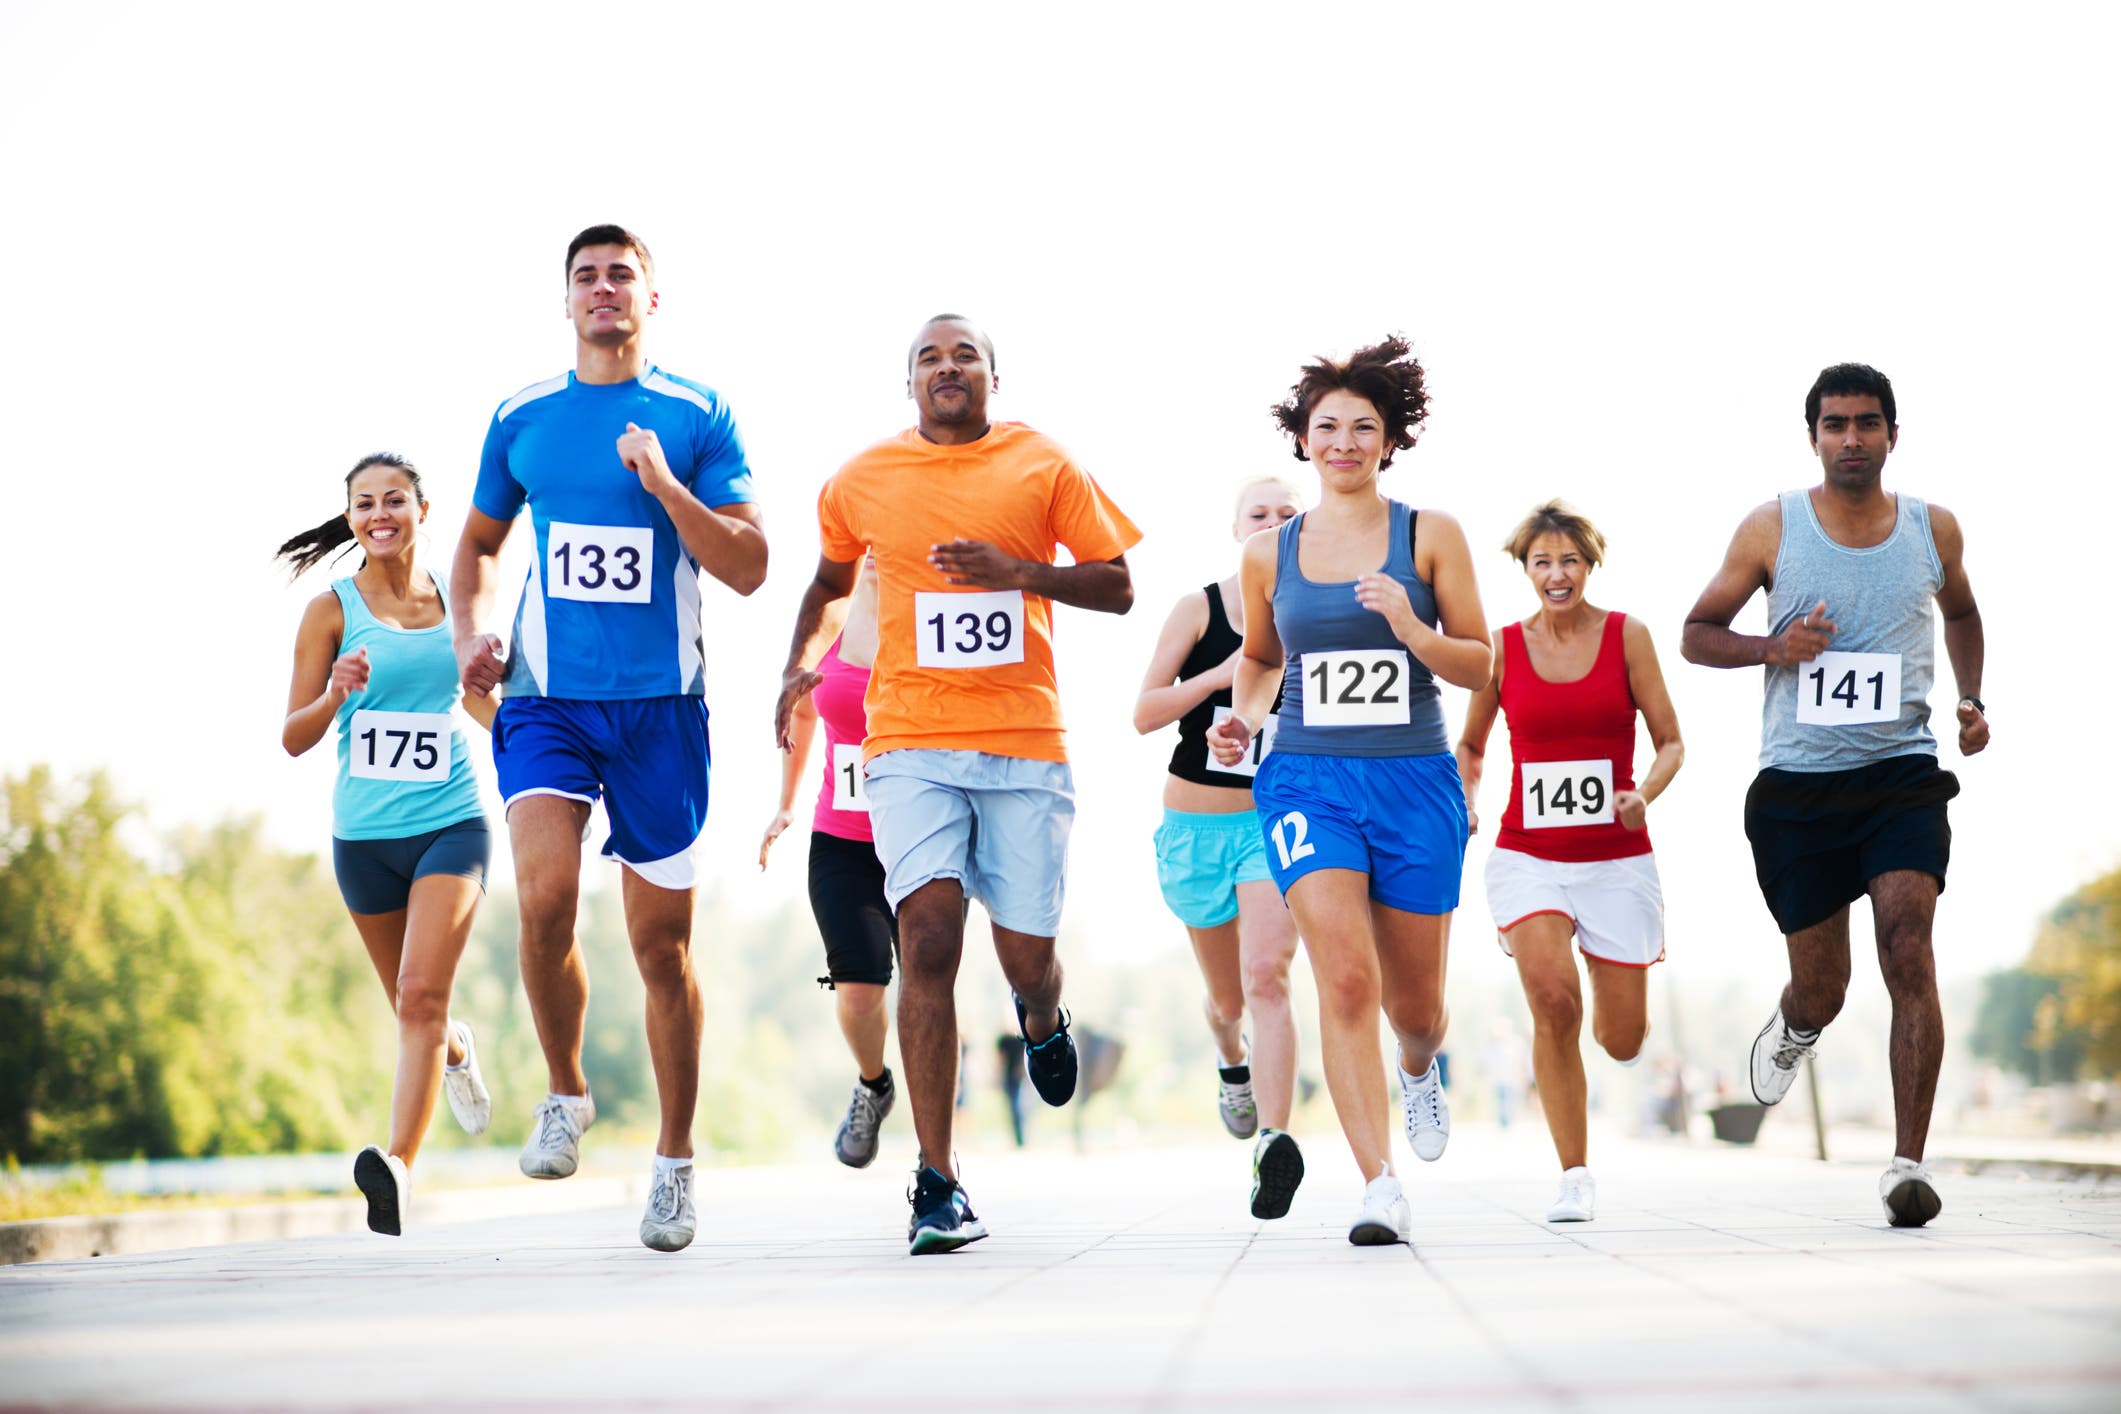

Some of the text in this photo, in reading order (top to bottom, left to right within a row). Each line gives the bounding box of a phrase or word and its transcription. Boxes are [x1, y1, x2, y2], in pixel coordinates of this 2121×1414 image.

[554, 542, 641, 591] 133
[927, 611, 1012, 654] 139
[1309, 660, 1399, 704] 122
[1808, 666, 1885, 711] 141
[359, 727, 438, 770] 175
[1528, 776, 1605, 816] 149
[1270, 811, 1316, 870] 12
